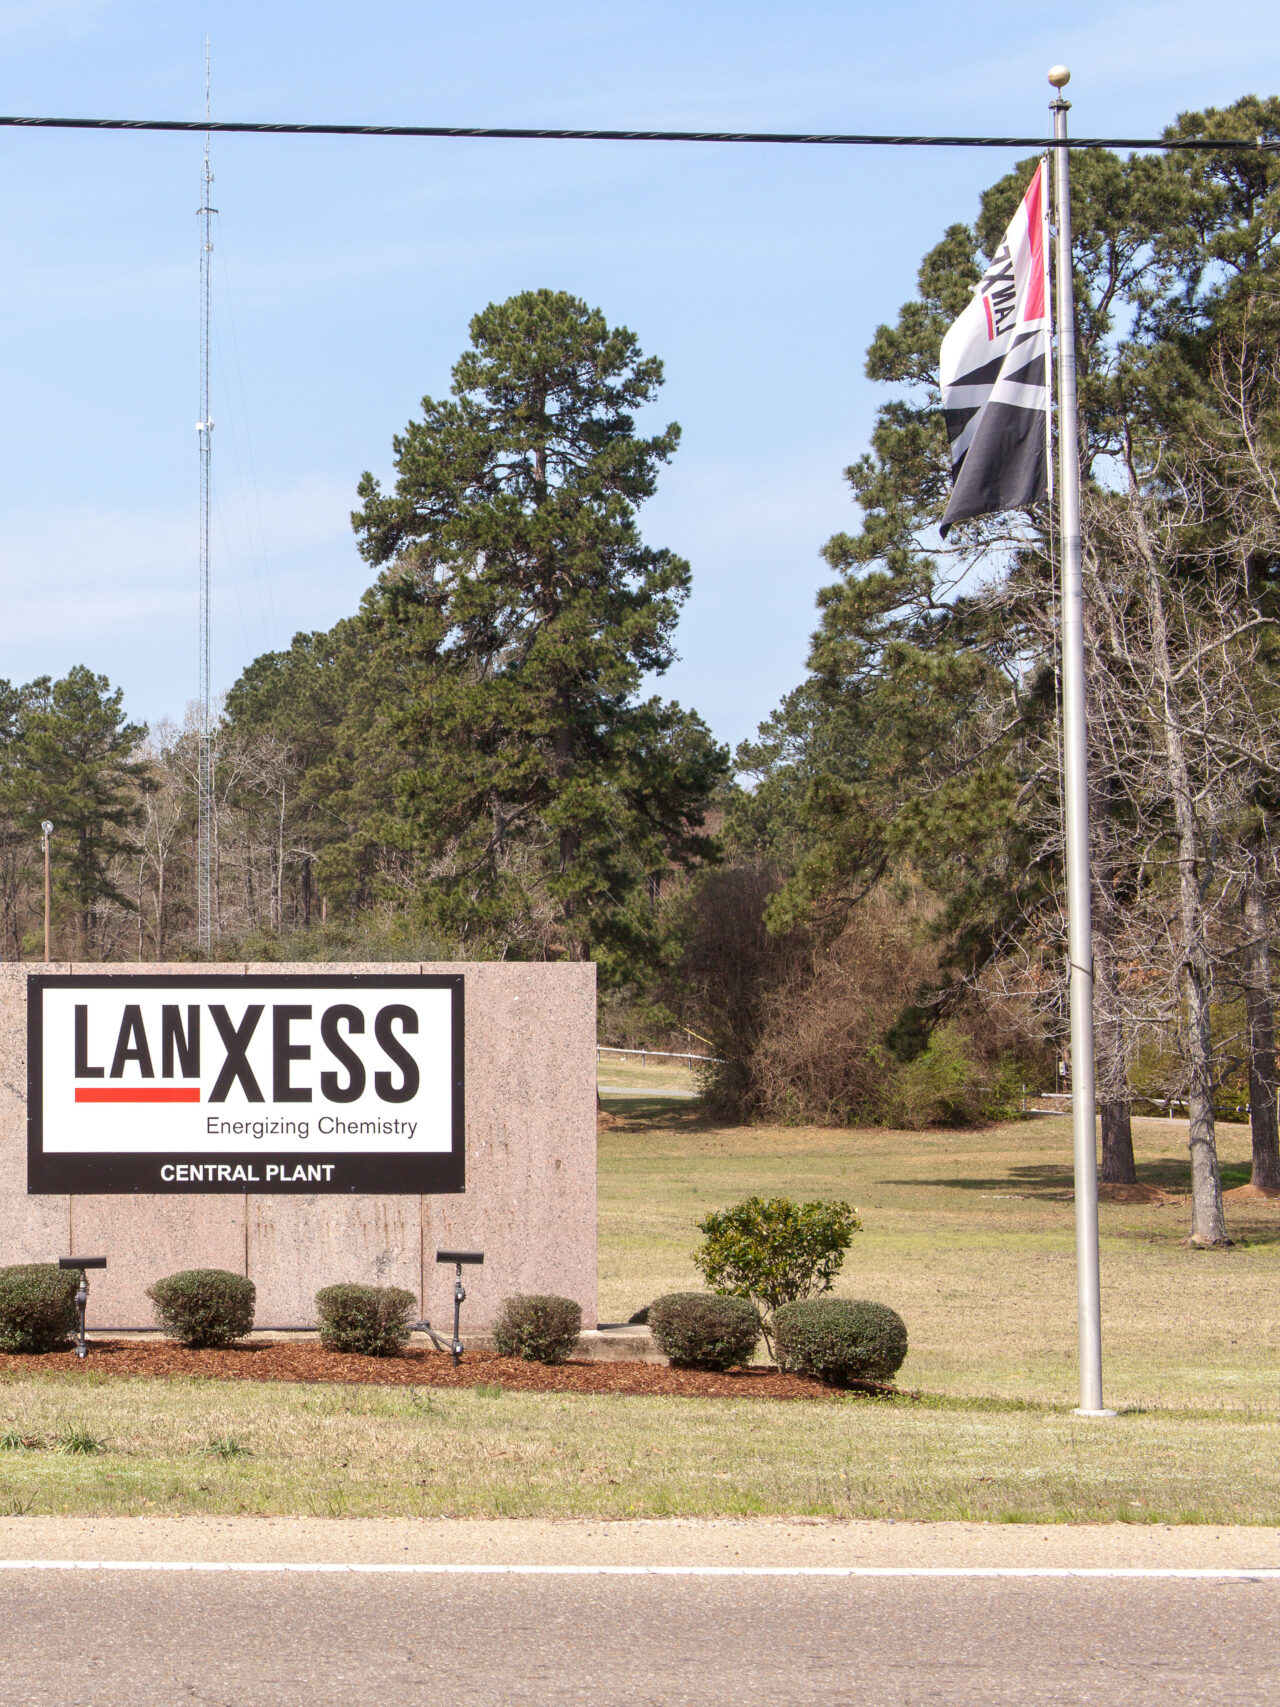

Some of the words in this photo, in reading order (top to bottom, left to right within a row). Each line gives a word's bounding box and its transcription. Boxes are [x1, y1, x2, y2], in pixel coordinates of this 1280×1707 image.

[74, 1003, 420, 1103] LANXESS
[207, 1116, 310, 1140] Energizing
[318, 1117, 418, 1140] Chemistry
[160, 1164, 260, 1182] CENTRAL
[265, 1164, 336, 1182] PLANT
